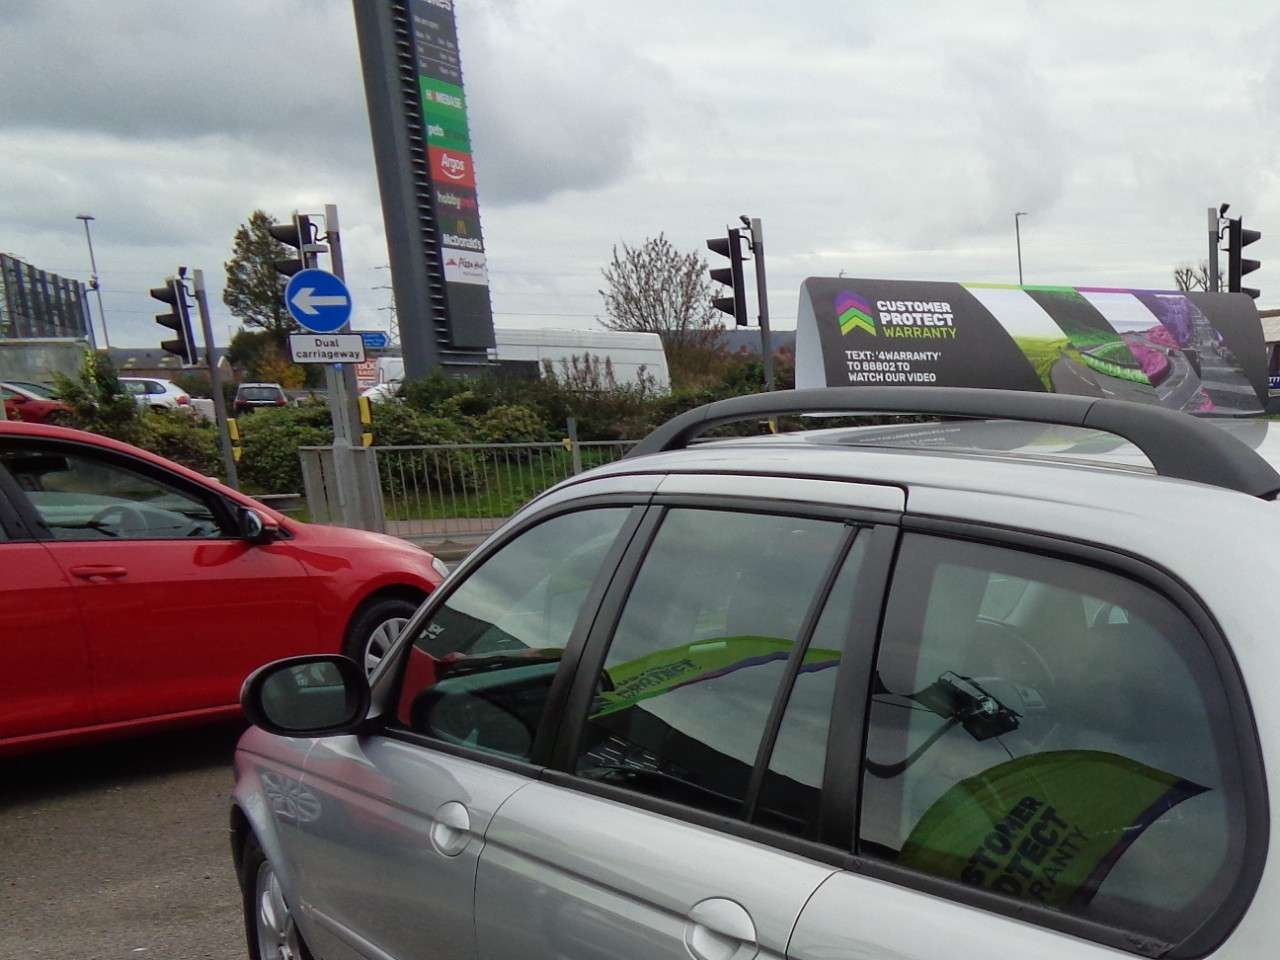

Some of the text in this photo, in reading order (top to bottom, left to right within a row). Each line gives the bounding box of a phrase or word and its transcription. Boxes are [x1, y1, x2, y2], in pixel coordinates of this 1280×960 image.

[441, 153, 465, 172] Argos
[876, 300, 952, 313] CUSTOMER
[880, 312, 954, 326] PROTECT
[882, 326, 957, 339] WARRANTY
[314, 338, 340, 347] Dual
[296, 350, 360, 360] carriageway
[845, 350, 875, 360] TEXT:
[847, 361, 861, 371] TO
[897, 362, 910, 371] TO
[848, 371, 937, 382] WATCH OUR VIDEO
[960, 795, 1044, 886] STOMER
[991, 805, 1069, 897] OTECT
